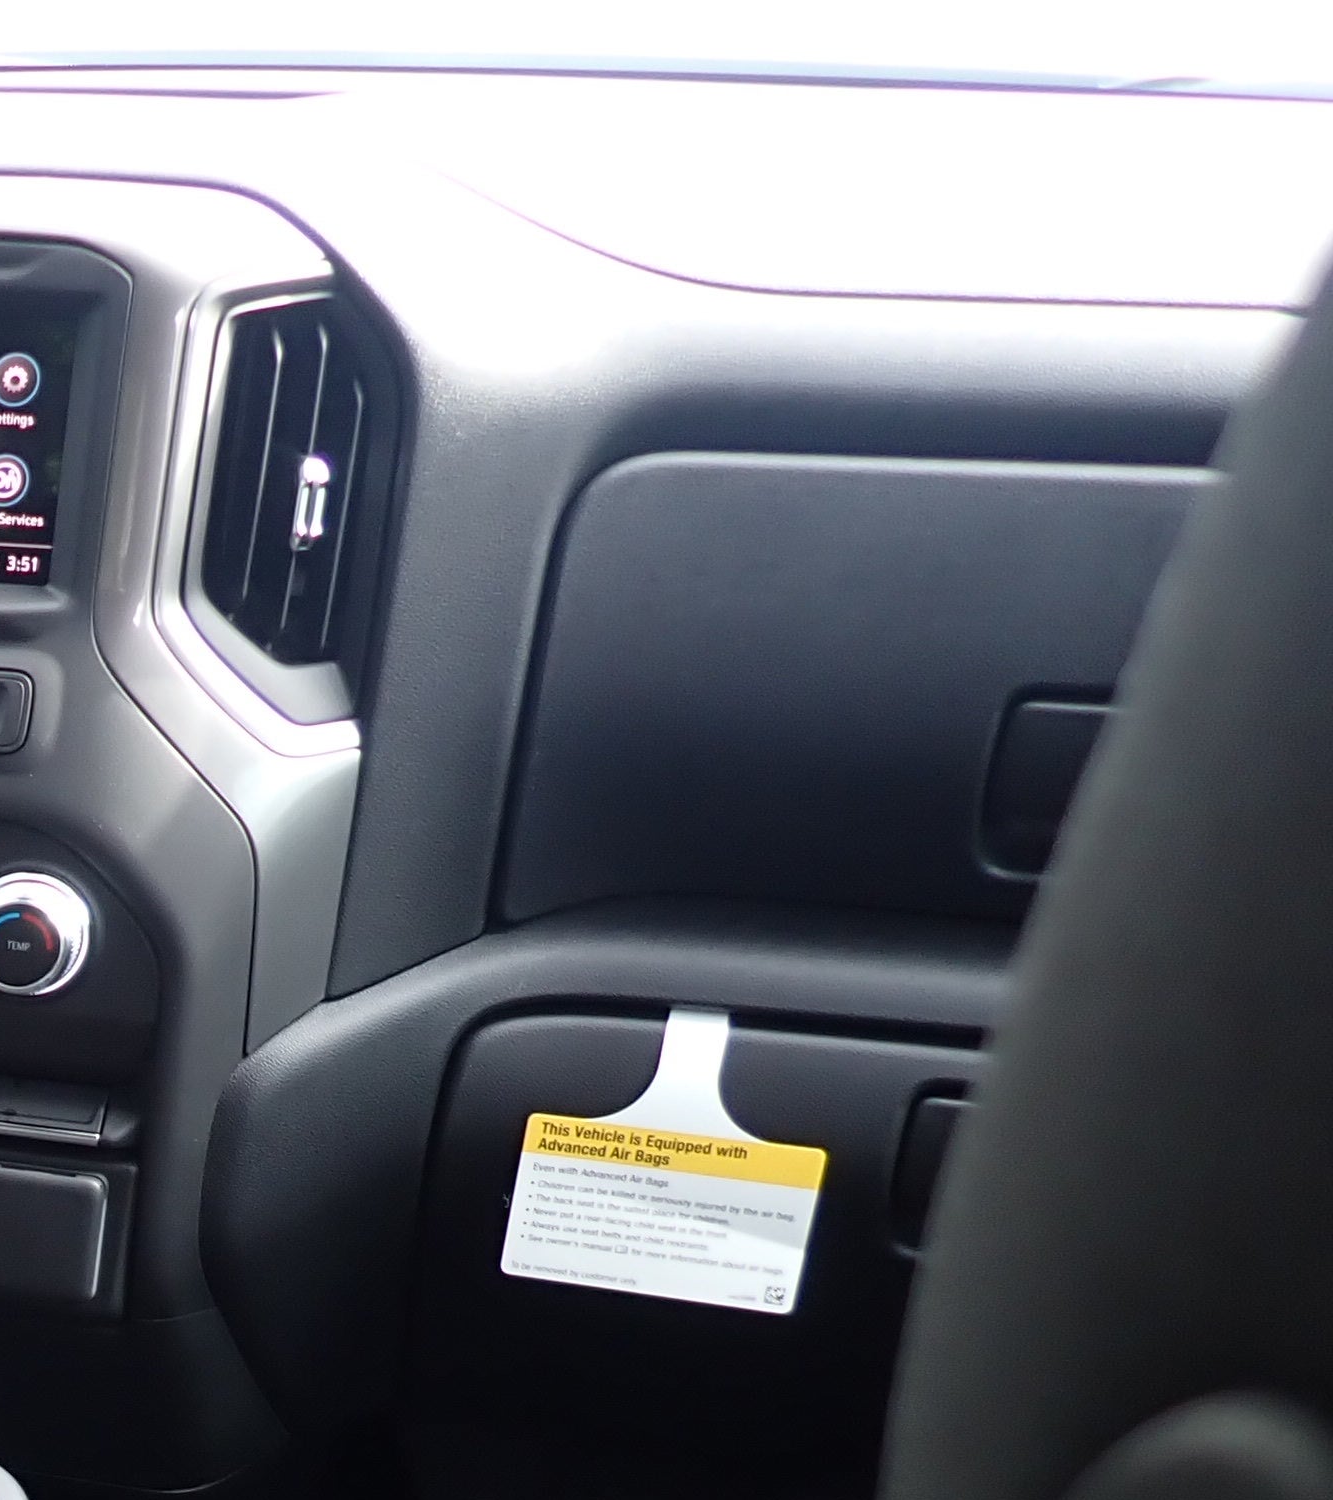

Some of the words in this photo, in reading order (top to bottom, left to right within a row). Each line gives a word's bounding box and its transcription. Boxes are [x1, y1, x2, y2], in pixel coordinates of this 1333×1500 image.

[6, 555, 39, 572] 3:51
[537, 1137, 606, 1157] Advanced
[610, 1146, 631, 1160] Air
[635, 1149, 670, 1167] Bags
[542, 1122, 570, 1137] This
[575, 1125, 625, 1144] Vehicle
[630, 1132, 642, 1146] is
[646, 1135, 712, 1155] Equipped
[717, 1145, 748, 1159] with
[533, 1162, 555, 1172] Even
[559, 1166, 578, 1175] with
[581, 1169, 627, 1181] Advanced
[629, 1175, 643, 1183] Air
[645, 1177, 669, 1188] Bags
